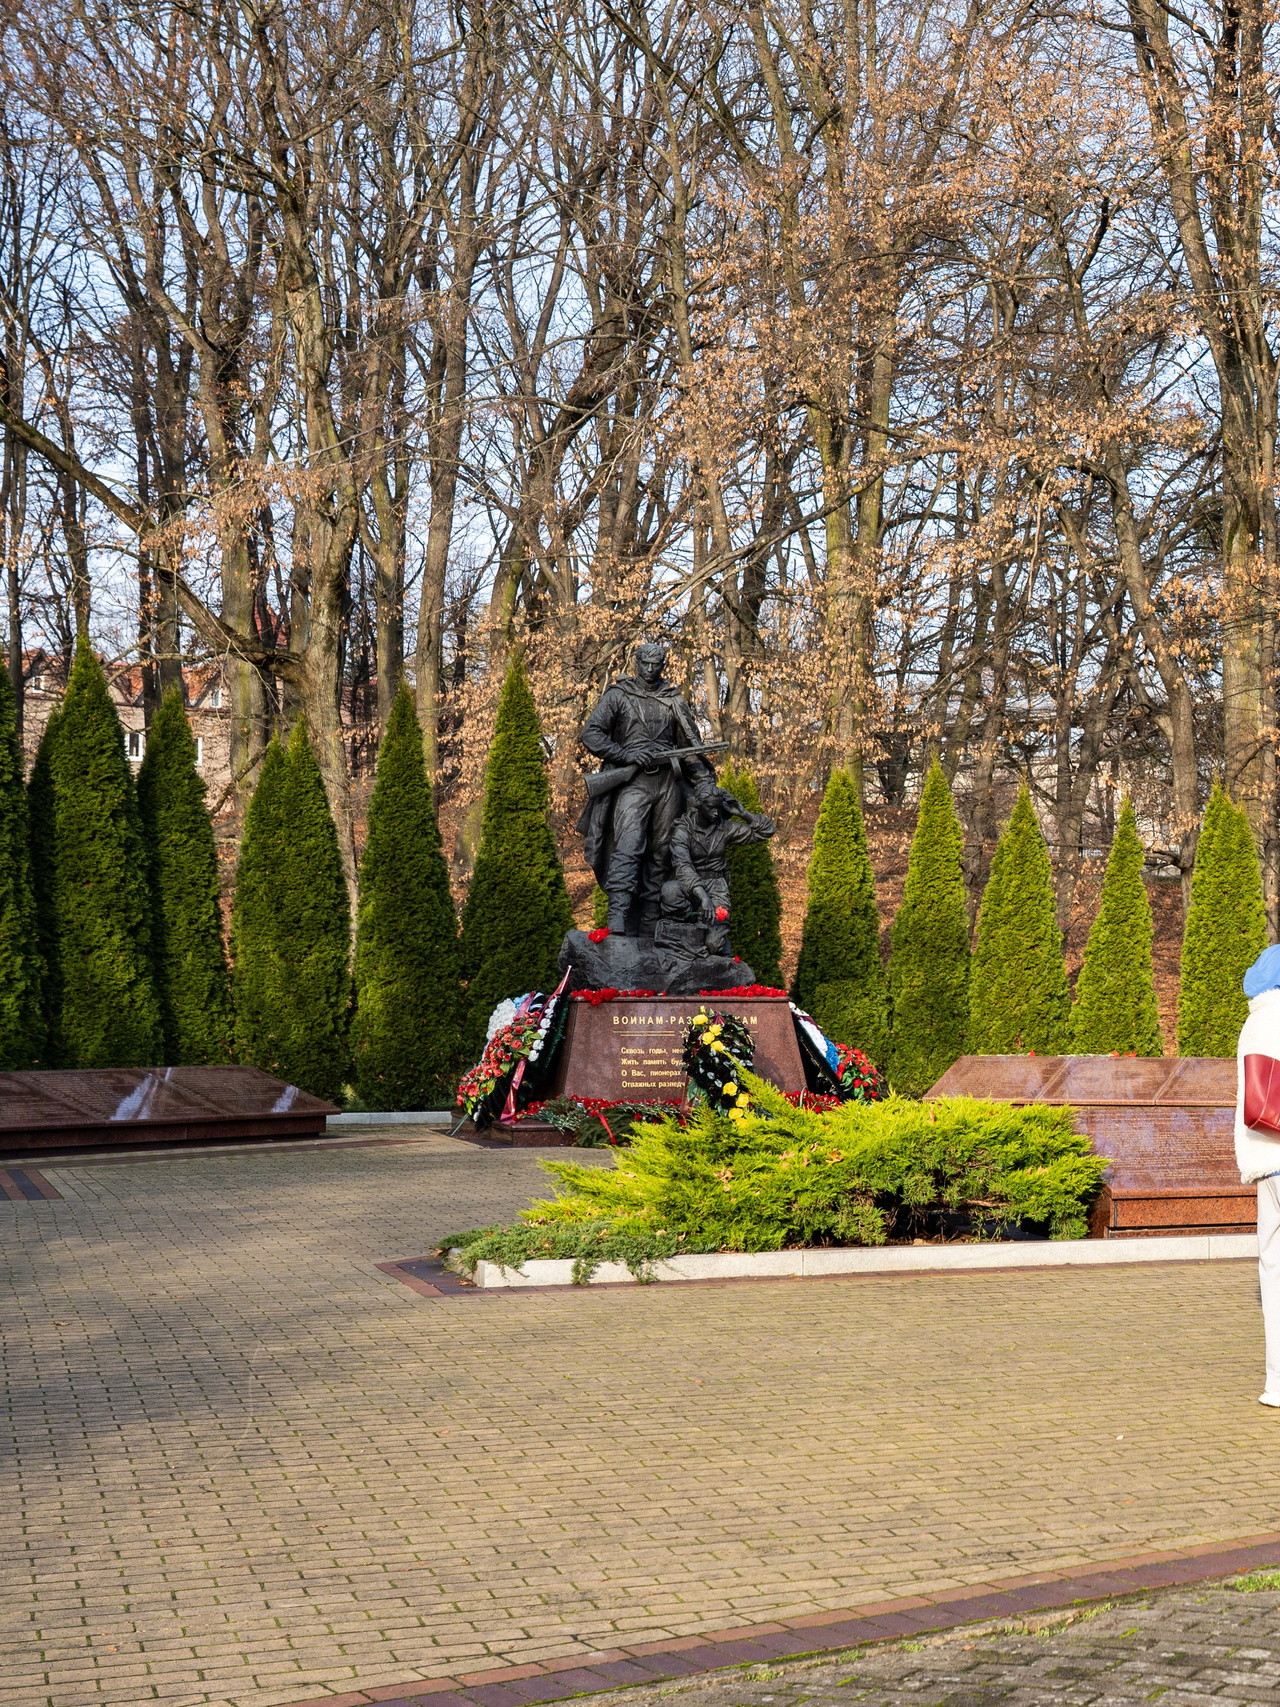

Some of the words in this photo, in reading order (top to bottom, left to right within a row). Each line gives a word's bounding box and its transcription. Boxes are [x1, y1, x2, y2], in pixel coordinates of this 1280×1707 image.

[613, 1016, 758, 1025] ВОИНАМ-РАЗАМ
[620, 1046, 645, 1054] Сквозь
[621, 1069, 628, 1077] О
[631, 1069, 646, 1077] Вас,
[621, 1080, 657, 1088] Отважных
[658, 1081, 685, 1089] разведч
